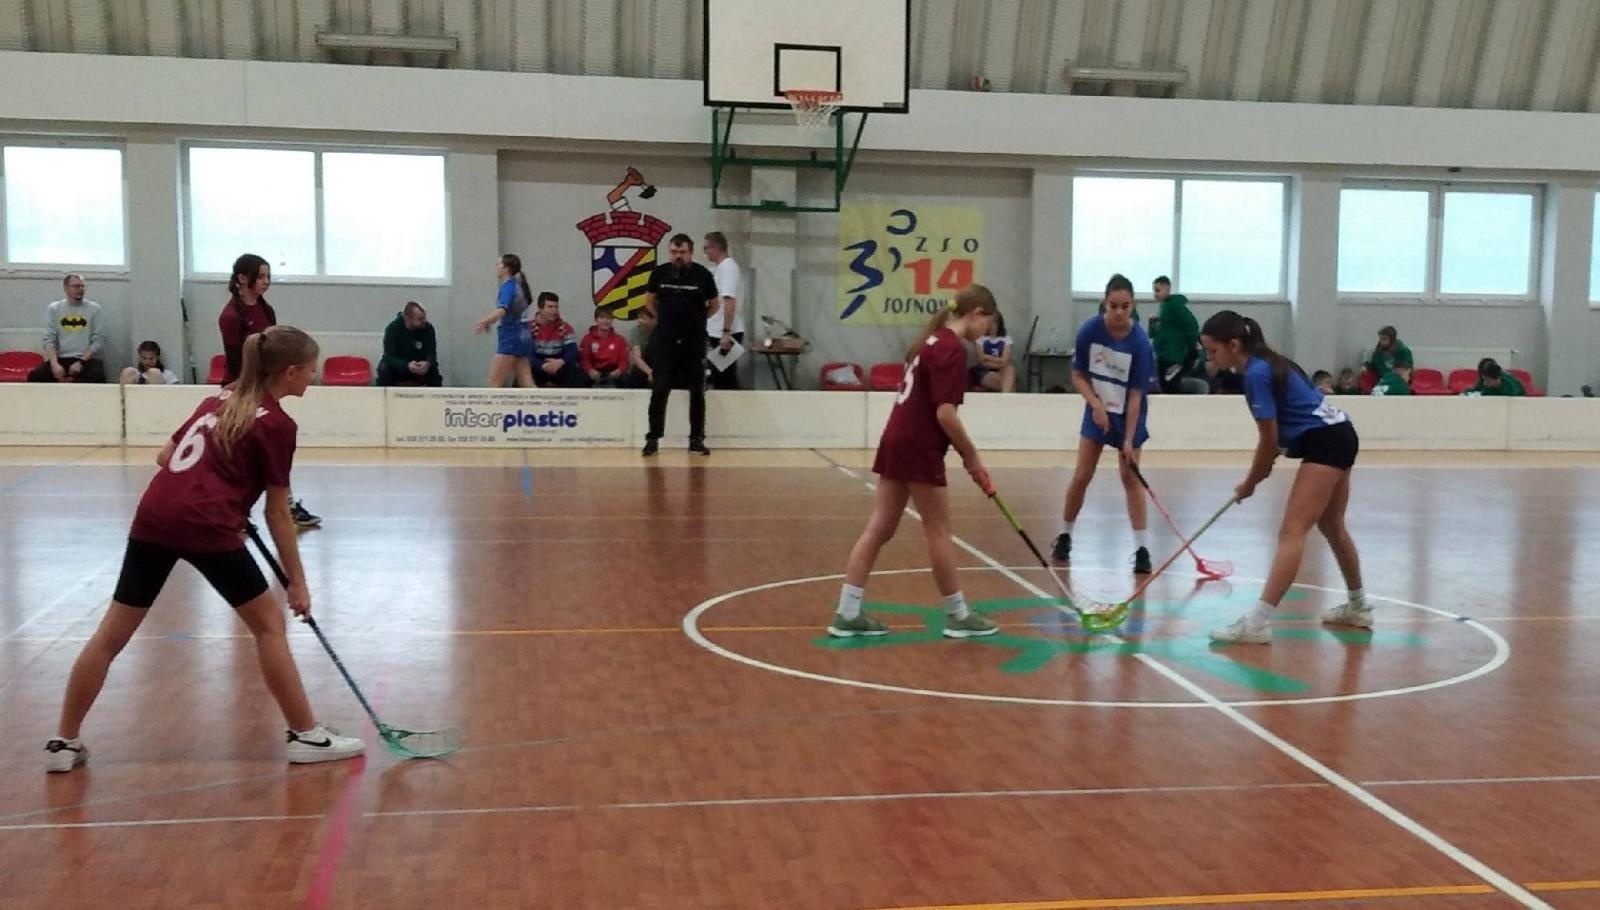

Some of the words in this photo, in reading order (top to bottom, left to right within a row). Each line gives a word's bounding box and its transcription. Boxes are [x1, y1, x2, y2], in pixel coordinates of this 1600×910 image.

[904, 258, 974, 295] 14
[444, 408, 578, 433] interplastic
[168, 412, 218, 474] 6
